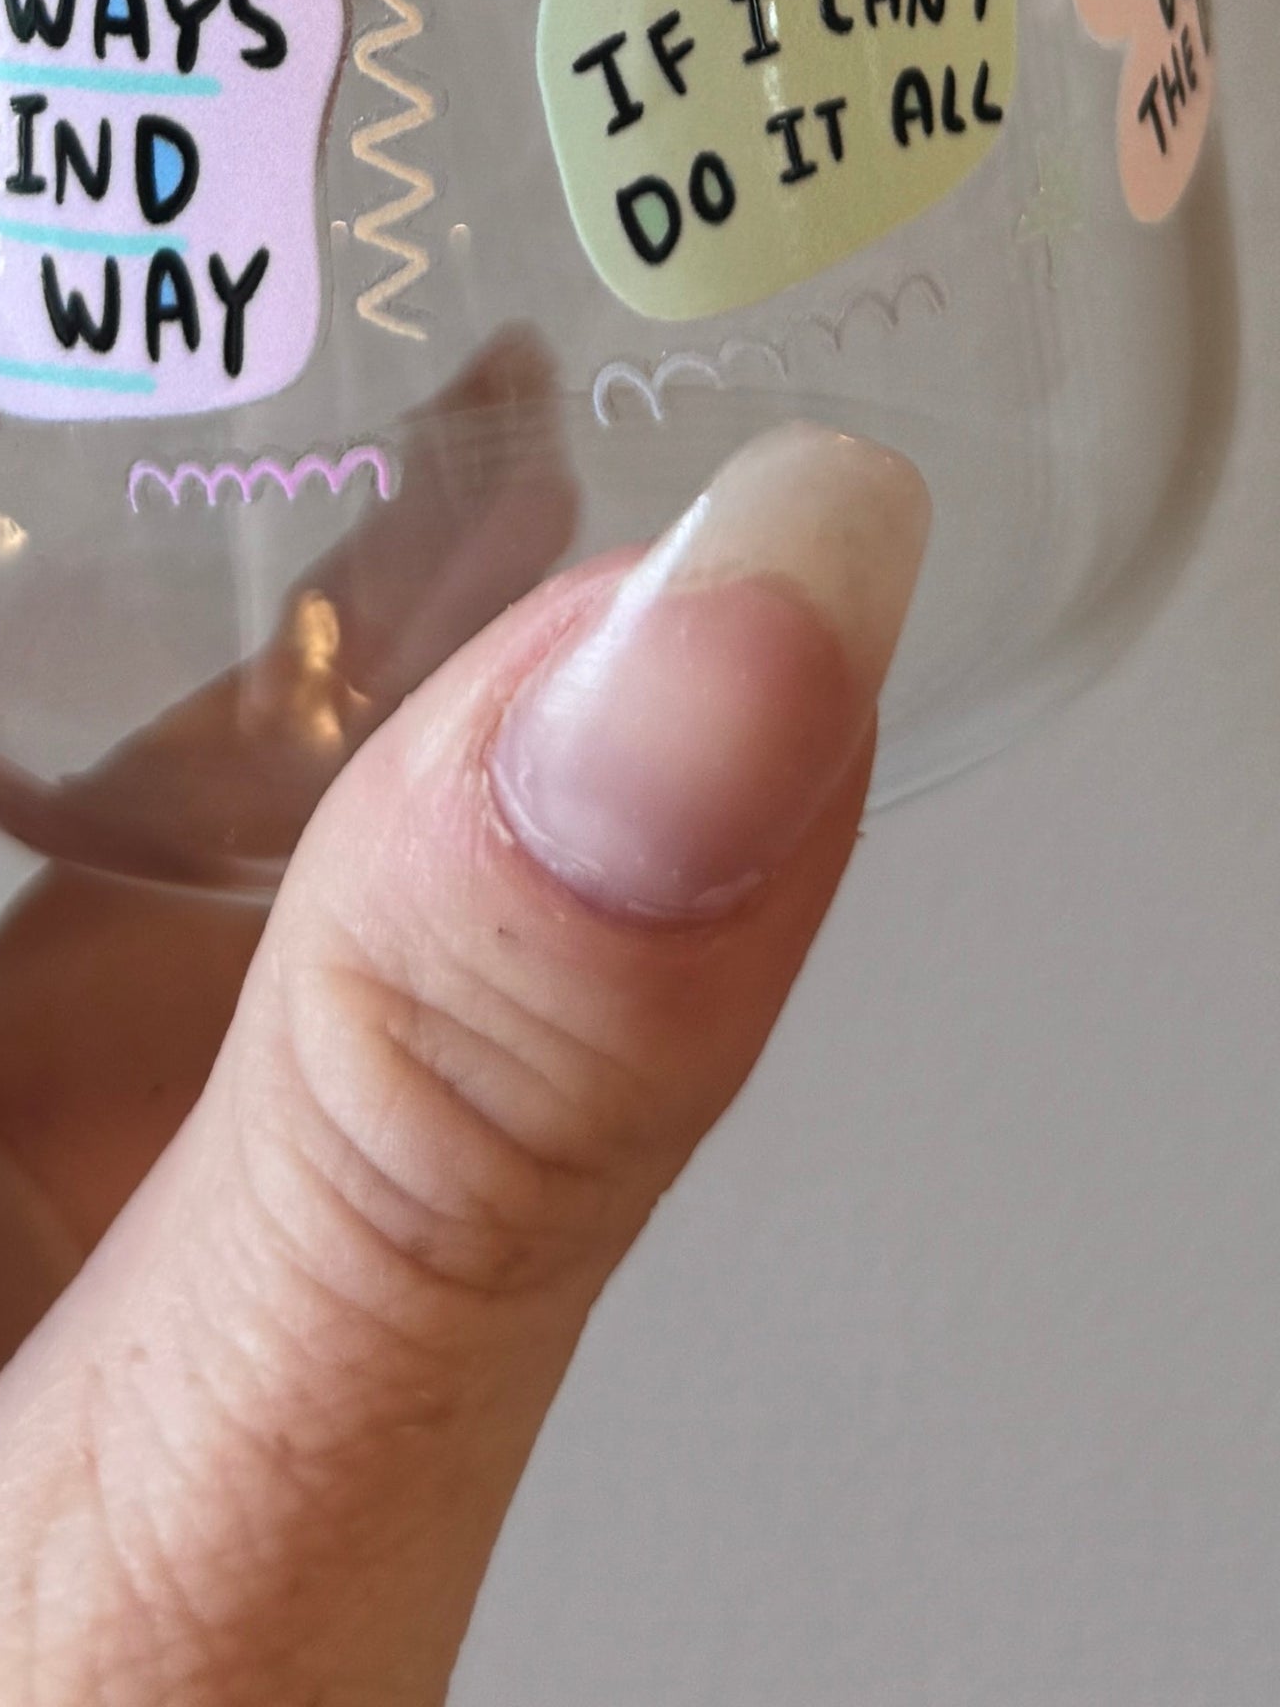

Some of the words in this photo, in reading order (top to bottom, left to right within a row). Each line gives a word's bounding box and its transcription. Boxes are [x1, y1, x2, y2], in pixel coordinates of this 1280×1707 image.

[572, 10, 695, 136] IF
[1138, 25, 1198, 155] THE
[616, 150, 737, 266] DO
[766, 97, 847, 185] IT
[892, 59, 1003, 147] ALL
[41, 246, 269, 378] WAY
